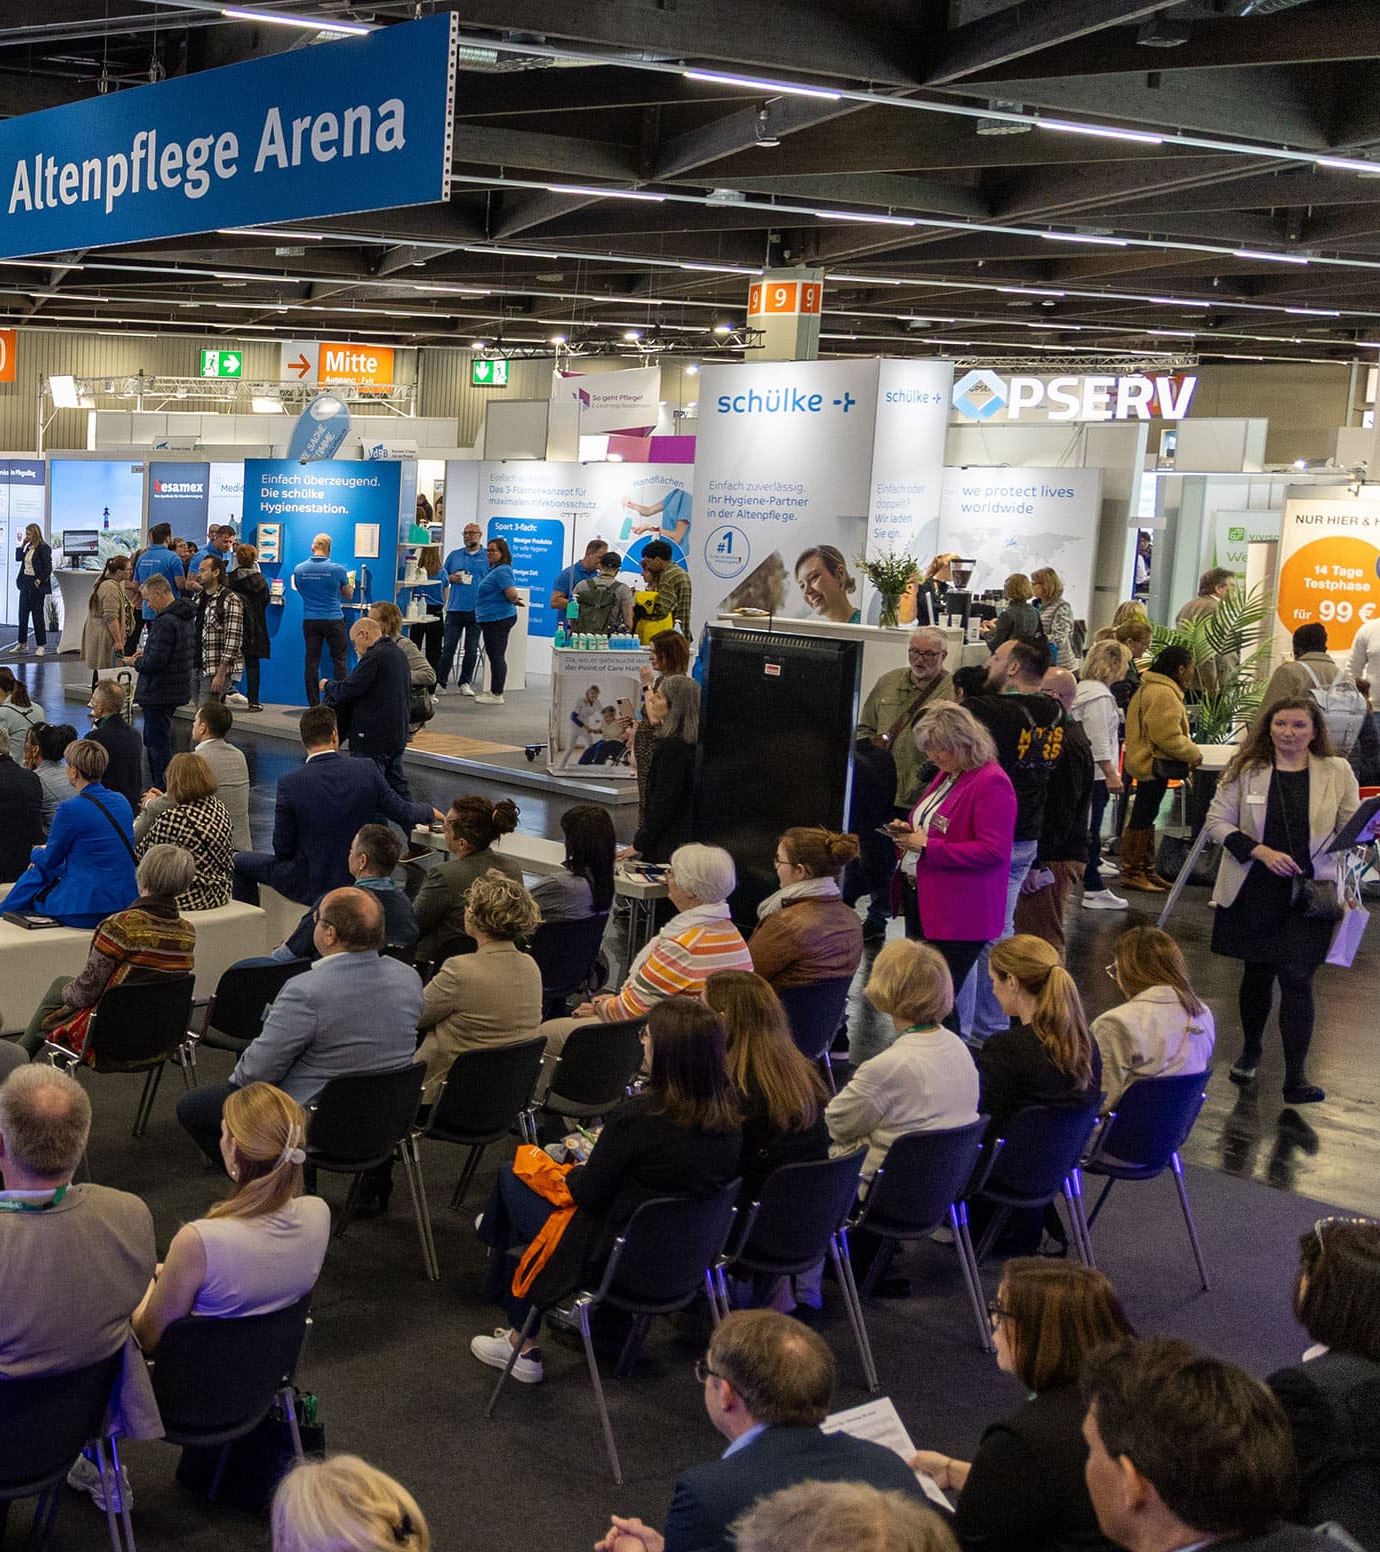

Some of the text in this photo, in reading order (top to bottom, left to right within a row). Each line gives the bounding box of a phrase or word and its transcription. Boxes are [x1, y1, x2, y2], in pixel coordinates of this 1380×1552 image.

[8, 97, 407, 214] Altenpflege Arena
[752, 288, 814, 309] 9 9 9
[325, 351, 378, 373] Mitte
[717, 387, 823, 414] schülke
[885, 389, 929, 403] schülke
[154, 479, 204, 493] besamex
[262, 474, 380, 489] Einfach überzeugend.
[709, 481, 806, 495] Einfach zuverlässig.
[261, 487, 325, 499] Die schülke
[489, 485, 504, 494] Das
[575, 487, 587, 496] für
[876, 484, 906, 495] Einfach
[962, 484, 1075, 498] we protect lives
[708, 495, 809, 507] Ihr Hygiene-Partner
[961, 501, 1034, 514] worldwide
[260, 502, 349, 515] Hygienestation.
[707, 508, 797, 523] in der Altenpflege.
[874, 513, 912, 524] Wir laden
[1295, 515, 1323, 525] NUR
[1327, 515, 1358, 526] HIER
[1362, 517, 1370, 527] &
[494, 522, 537, 532] Spart 3-fach:
[873, 528, 886, 539] Sie
[717, 531, 733, 554] #1
[1314, 564, 1364, 579] 14 Tage
[1303, 577, 1371, 592] Testphase
[1293, 599, 1377, 624] für 99 €
